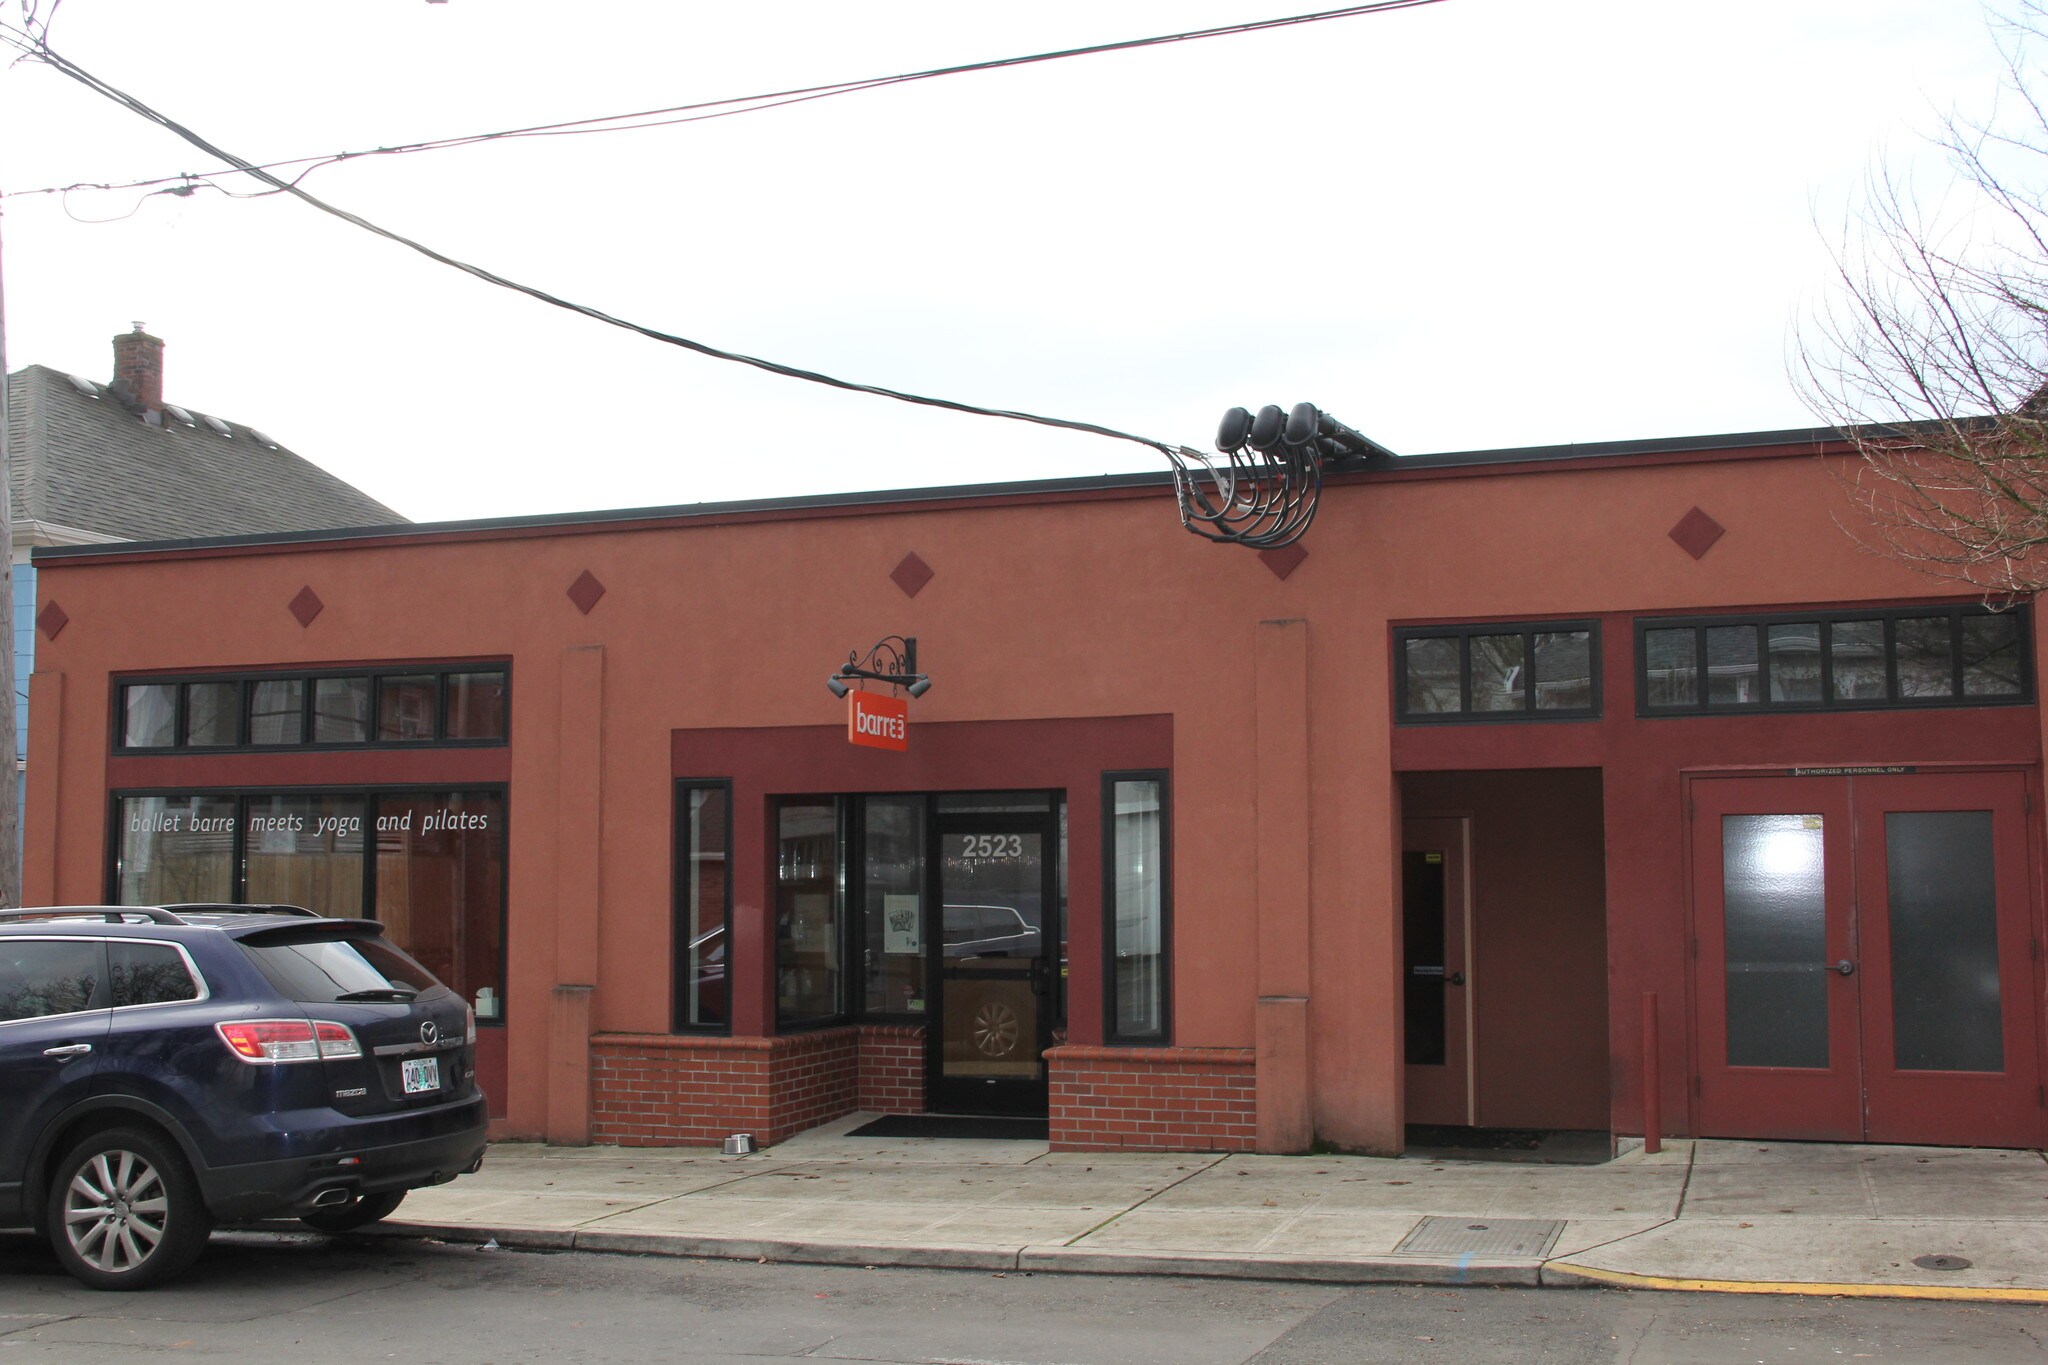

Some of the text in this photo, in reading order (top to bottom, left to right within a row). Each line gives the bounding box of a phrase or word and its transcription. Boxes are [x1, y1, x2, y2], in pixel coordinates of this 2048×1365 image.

[131, 809, 488, 837] ballet barre meets yoga and pilates
[962, 835, 1022, 858] 2523
